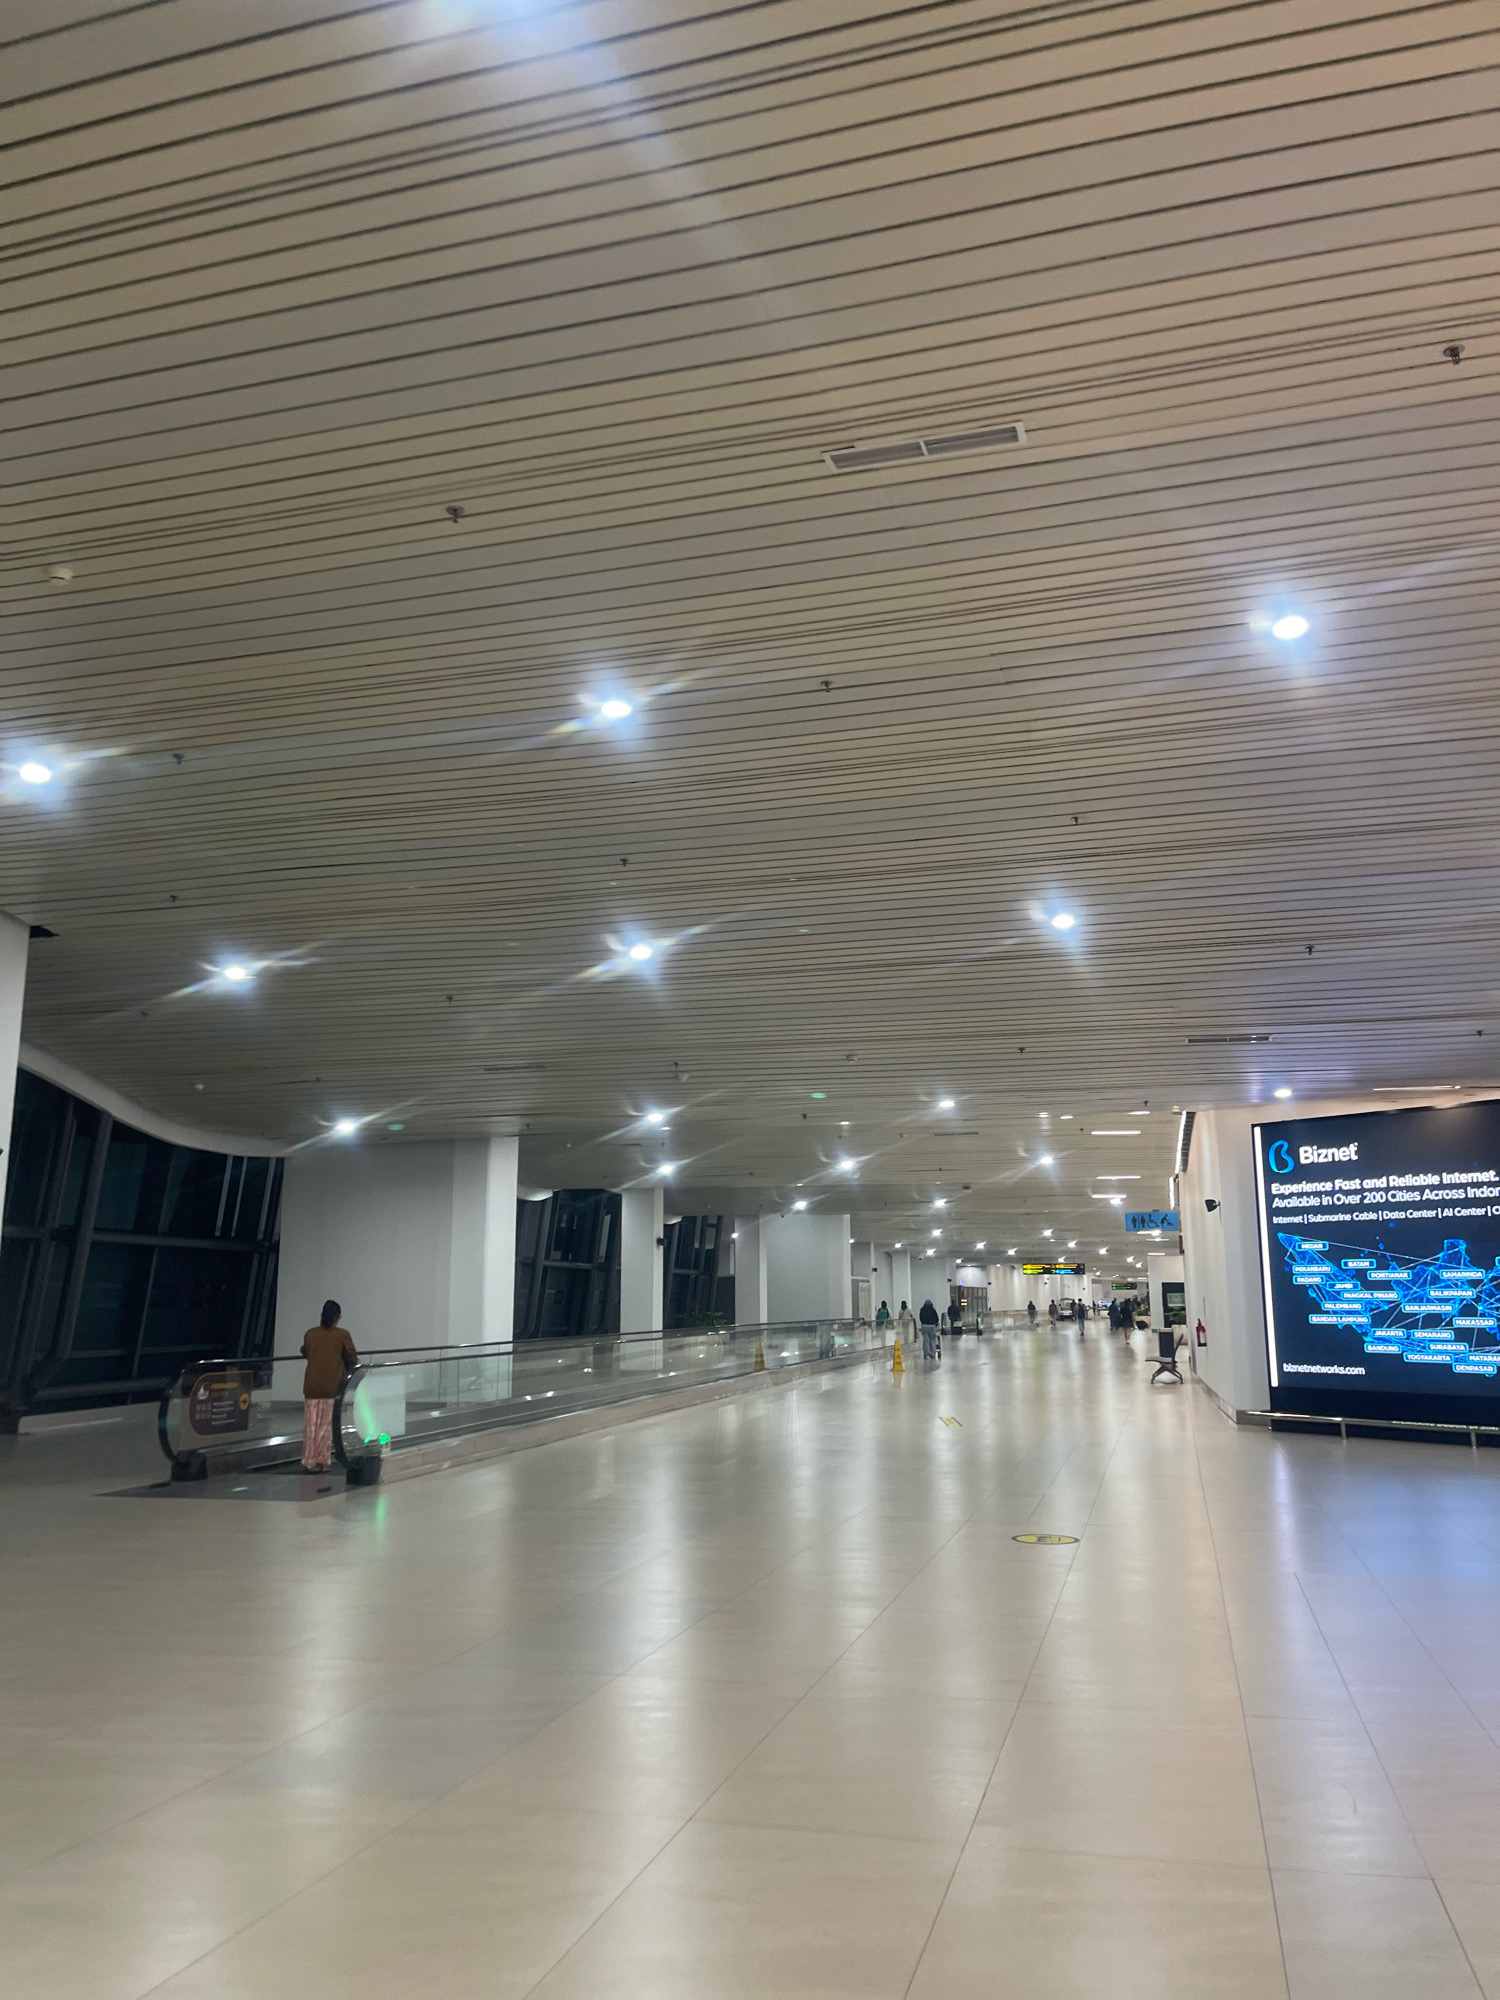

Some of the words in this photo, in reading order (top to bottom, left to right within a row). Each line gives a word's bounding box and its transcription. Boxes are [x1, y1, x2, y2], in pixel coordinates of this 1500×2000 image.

[1299, 1144, 1358, 1164] Biznet
[1271, 1181, 1333, 1195] Experience
[1334, 1179, 1361, 1190] Fast
[1362, 1176, 1387, 1188] and
[1389, 1173, 1440, 1187] Reliable
[1442, 1170, 1499, 1184] Internet.
[1272, 1195, 1320, 1208] Available
[1322, 1194, 1332, 1205] in
[1333, 1193, 1361, 1205] Over
[1363, 1191, 1386, 1203] 200
[1387, 1190, 1421, 1202] Cities
[1422, 1188, 1466, 1200] Across
[1272, 1215, 1303, 1224] Internet
[1308, 1212, 1351, 1222] Submarine
[1353, 1211, 1378, 1221] Cable
[1383, 1210, 1406, 1219] Data
[1406, 1208, 1437, 1218] Center
[1442, 1207, 1453, 1217] AI
[1454, 1207, 1486, 1217] Center
[1282, 1363, 1366, 1375] biznetnetworks.com
